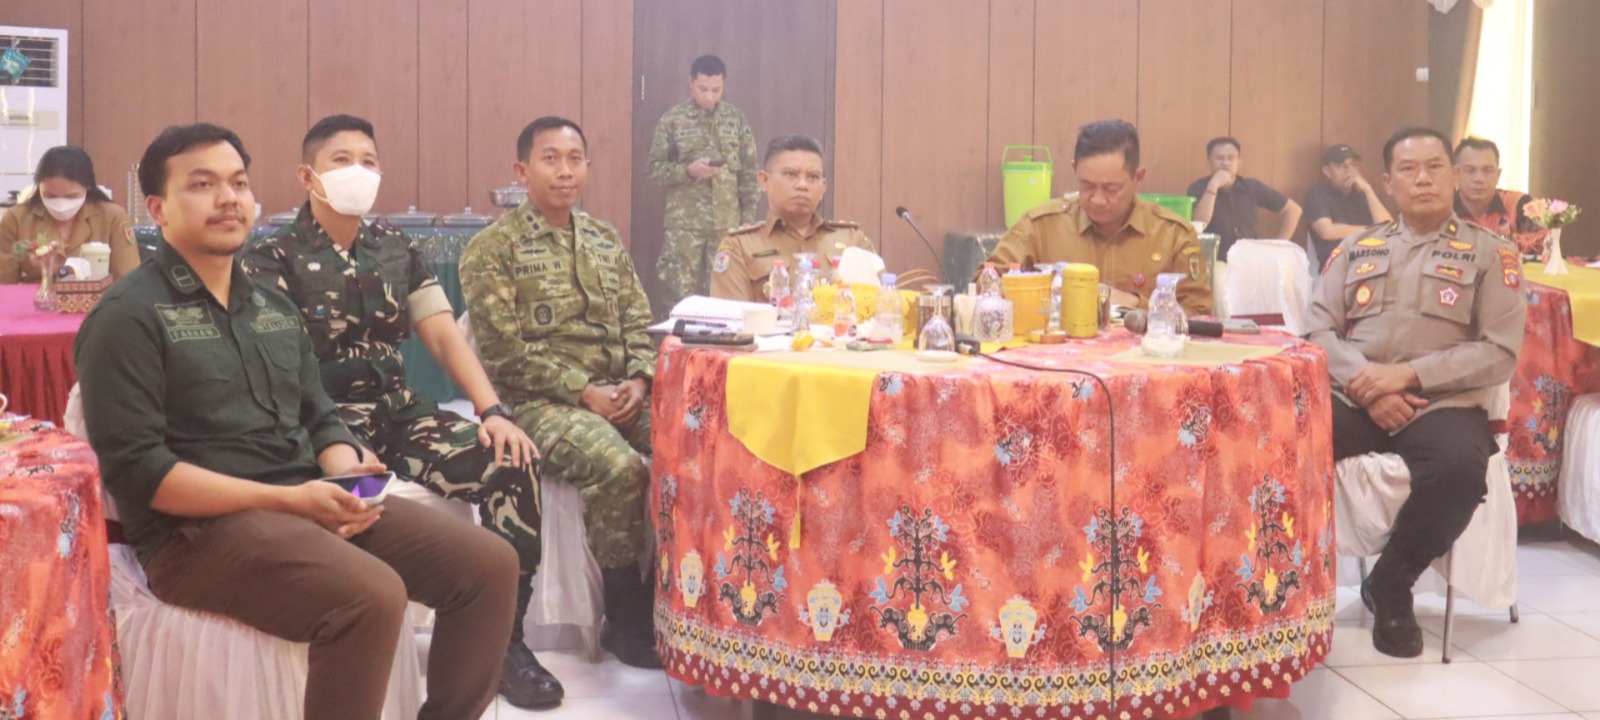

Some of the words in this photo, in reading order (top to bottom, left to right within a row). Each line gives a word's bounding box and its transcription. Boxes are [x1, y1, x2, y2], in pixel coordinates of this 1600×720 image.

[598, 254, 610, 264] TNI
[1431, 250, 1476, 262] POLRI
[515, 263, 548, 276] PRIMA
[552, 261, 561, 270] W
